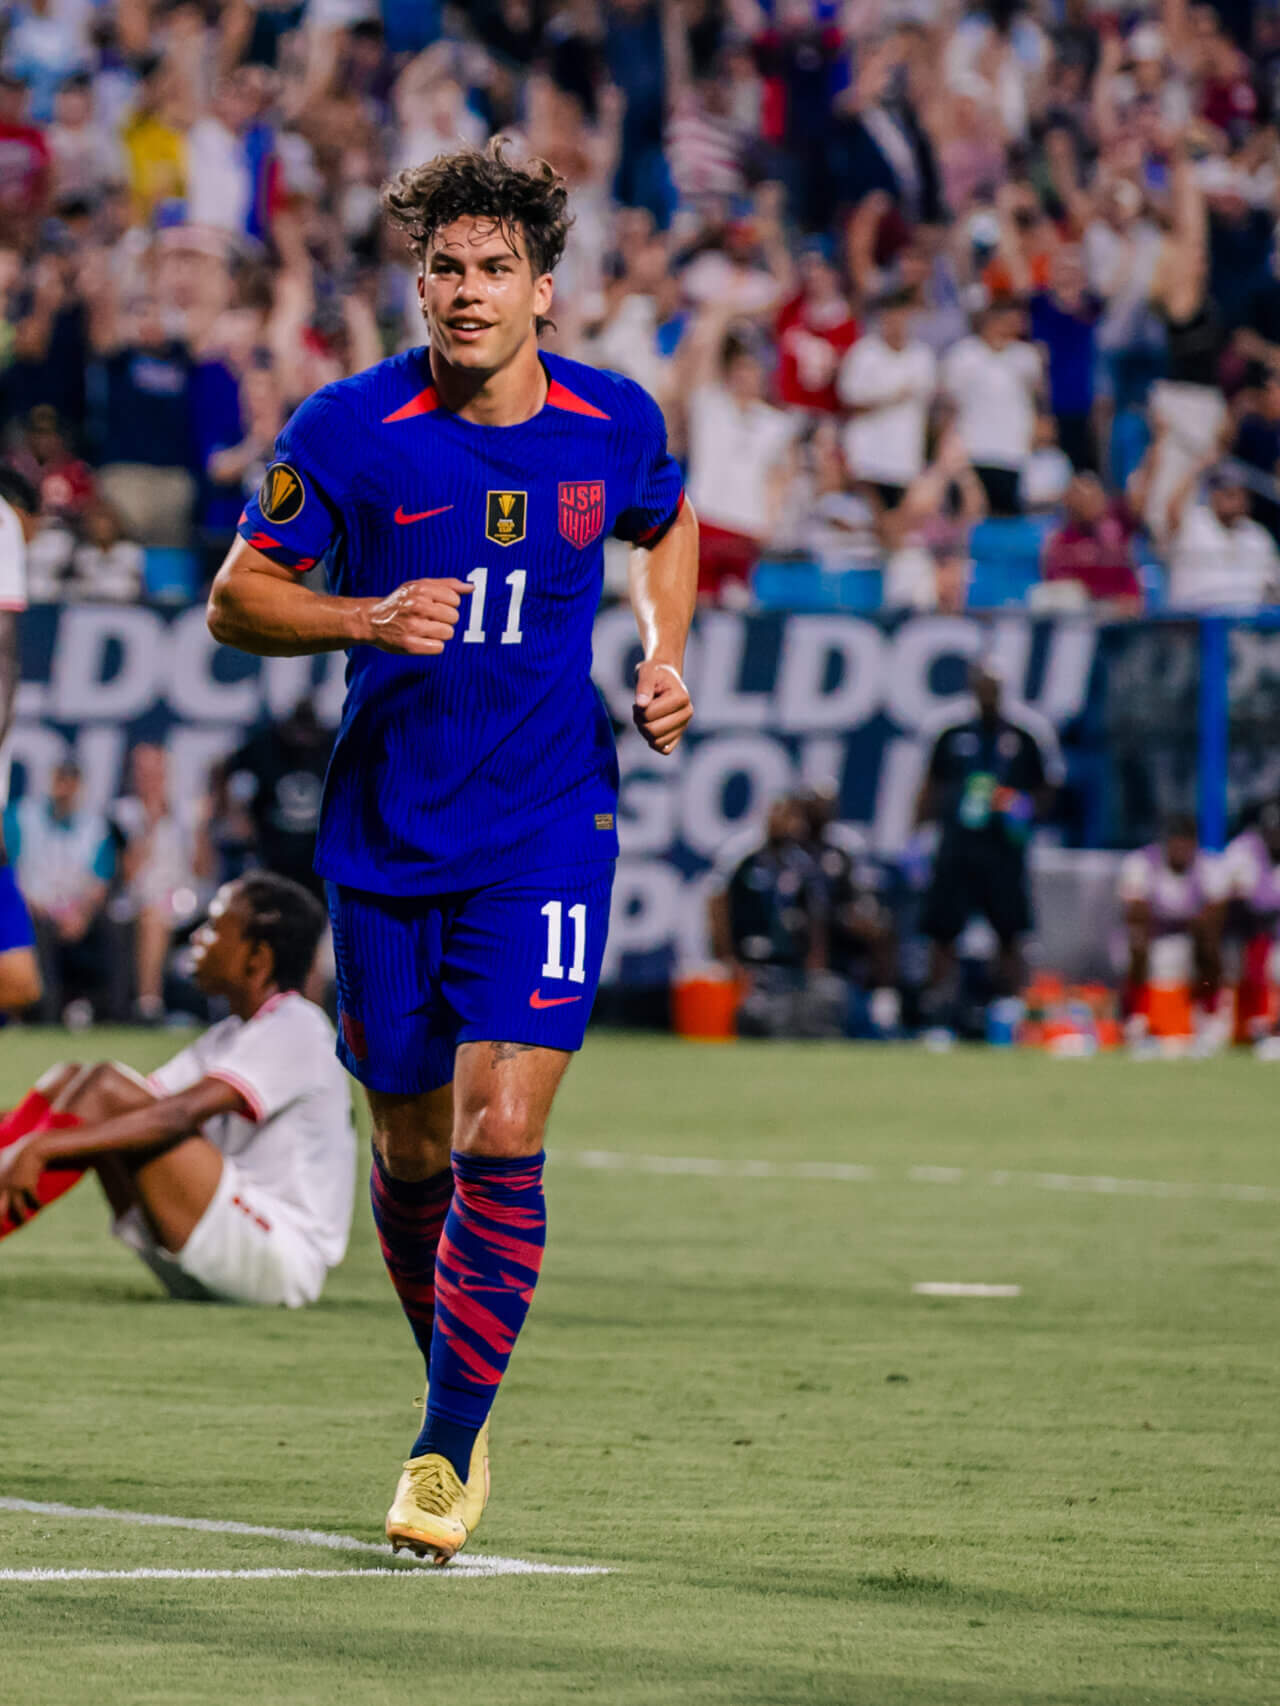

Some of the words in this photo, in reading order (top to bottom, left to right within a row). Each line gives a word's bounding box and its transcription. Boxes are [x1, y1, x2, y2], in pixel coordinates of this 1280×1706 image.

[563, 486, 600, 511] USA
[463, 567, 527, 644] 11
[541, 900, 586, 984] 11
